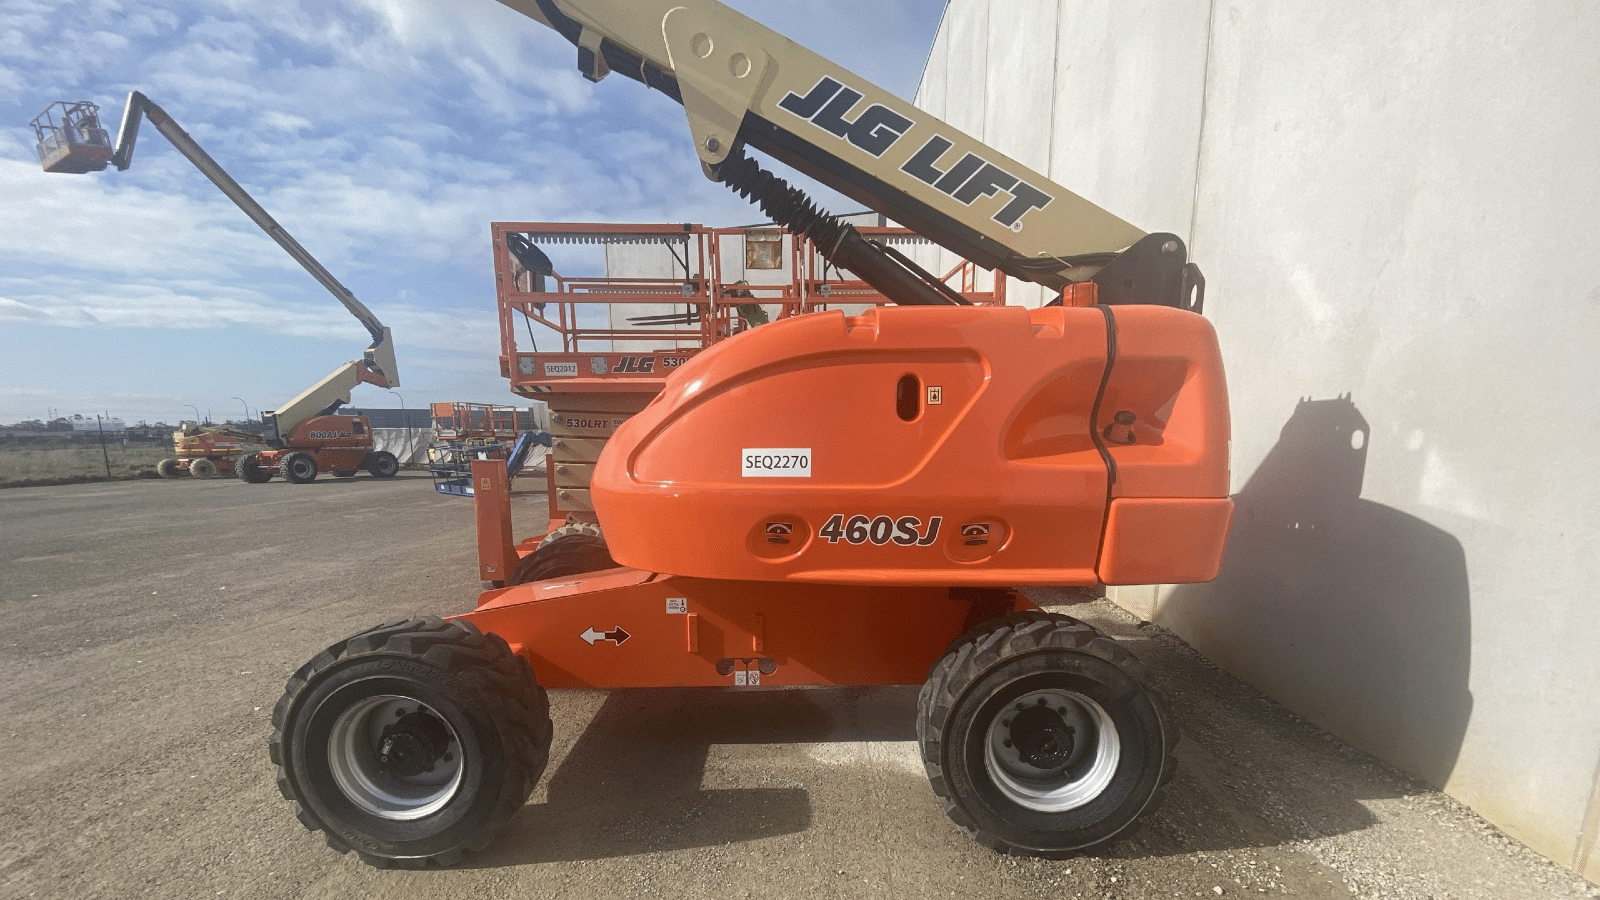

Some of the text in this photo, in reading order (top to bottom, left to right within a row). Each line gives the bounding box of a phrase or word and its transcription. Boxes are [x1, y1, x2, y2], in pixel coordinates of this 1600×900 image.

[776, 75, 1054, 229] JLG LIFT
[546, 365, 576, 373] SEQ2012
[612, 356, 656, 374] JLG
[566, 418, 608, 429] 530LRT
[745, 455, 809, 470] SEQ2270
[818, 513, 943, 547] 460SJ
